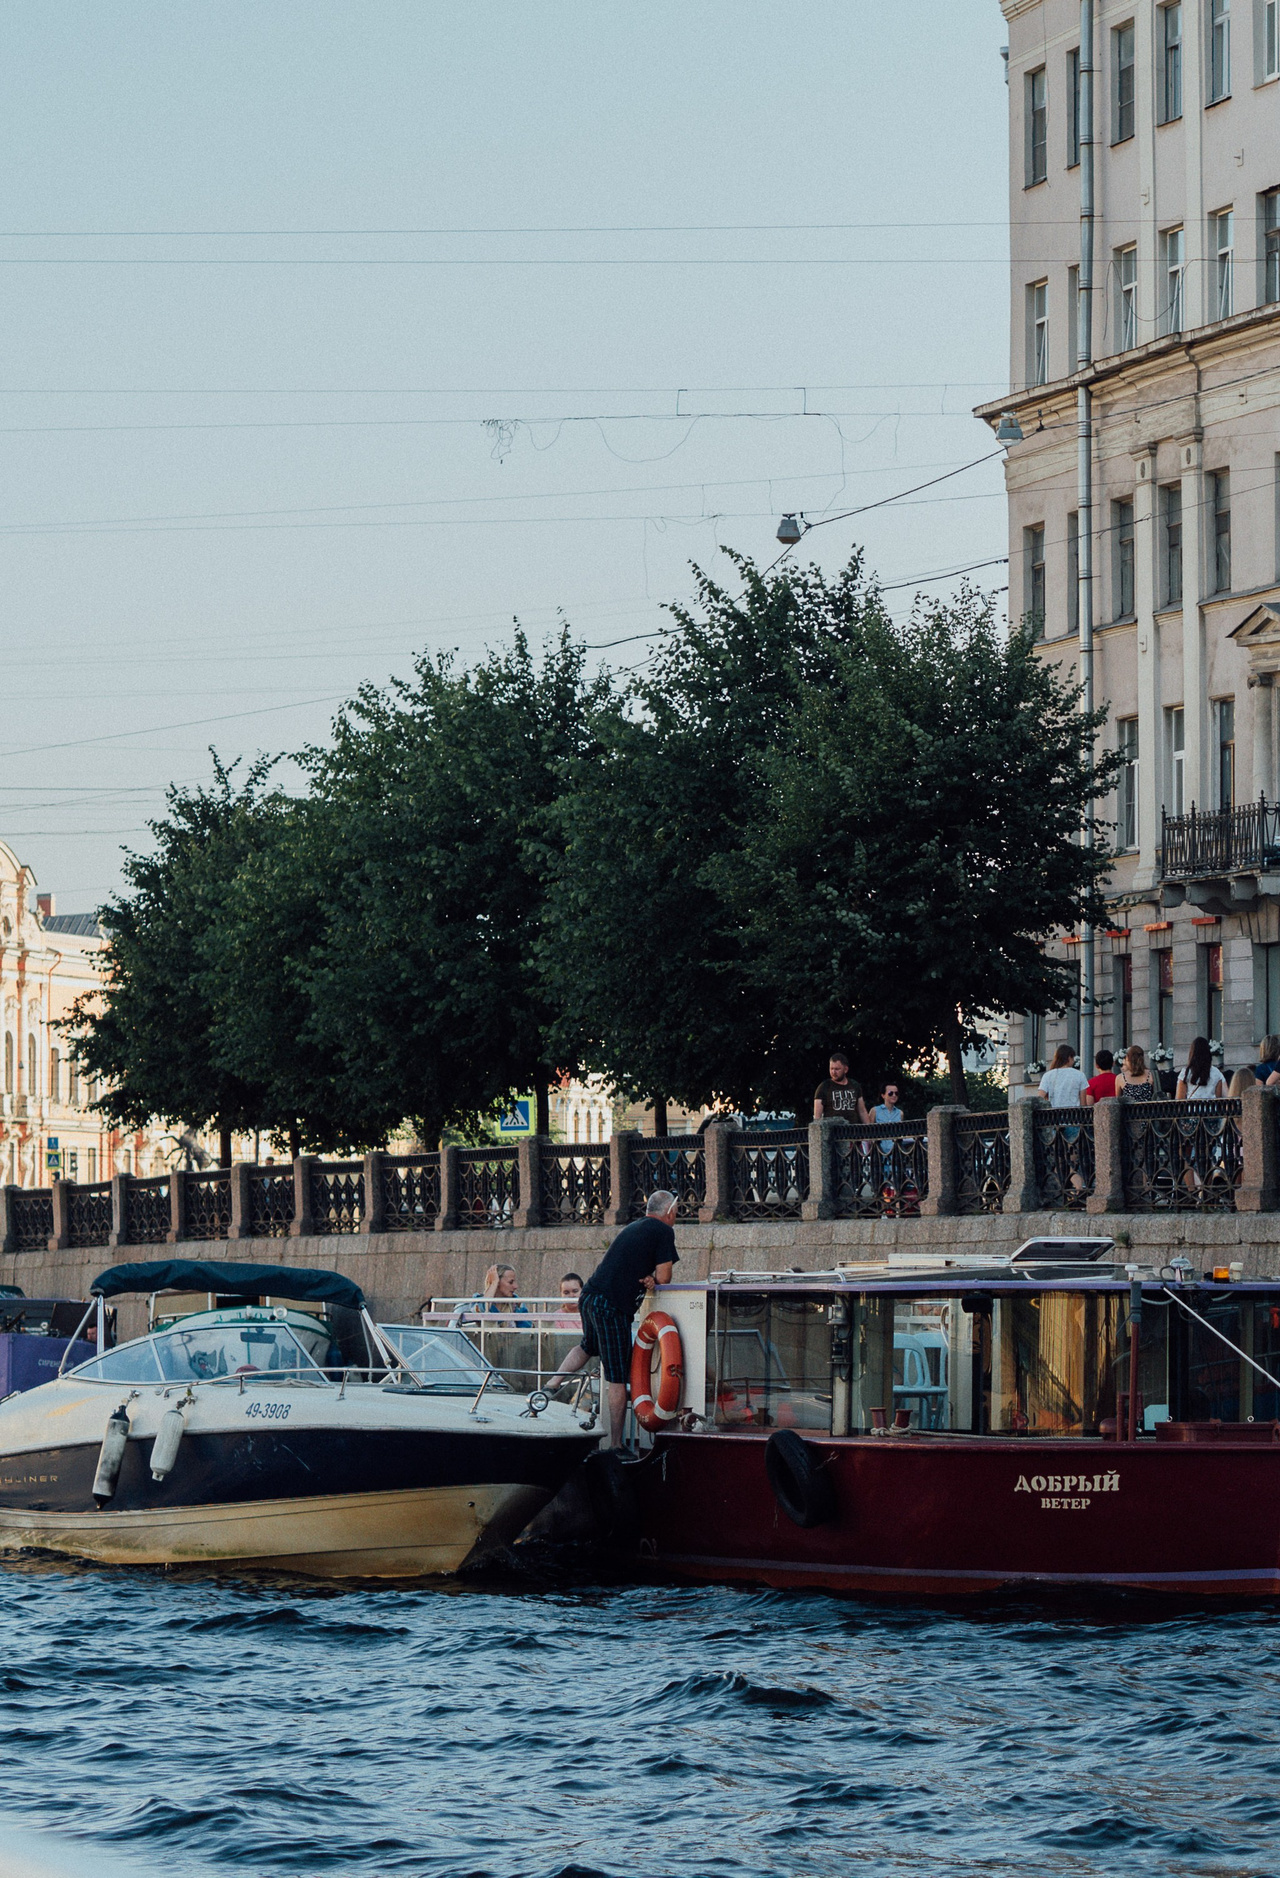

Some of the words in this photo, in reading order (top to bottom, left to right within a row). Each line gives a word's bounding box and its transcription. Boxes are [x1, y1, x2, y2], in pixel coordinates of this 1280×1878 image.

[832, 1090, 855, 1100] FUT
[245, 1402, 292, 1420] 49-3908
[1013, 1469, 1121, 1494] ДОБРЫЙ
[1040, 1497, 1091, 1510] ВЕТЕР
